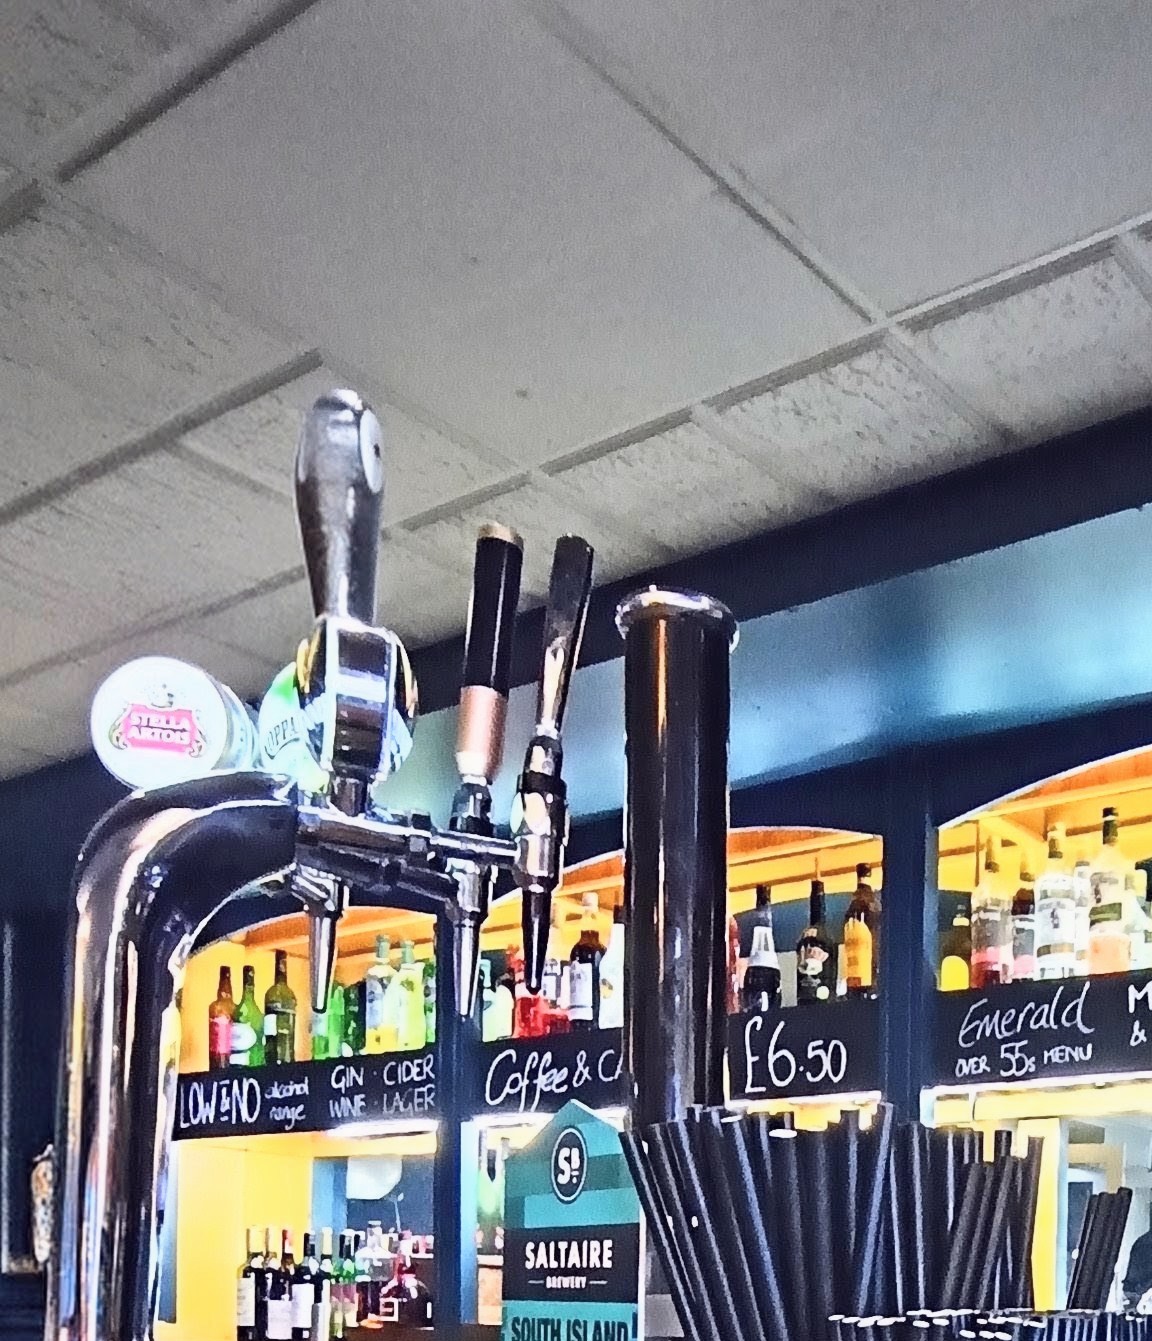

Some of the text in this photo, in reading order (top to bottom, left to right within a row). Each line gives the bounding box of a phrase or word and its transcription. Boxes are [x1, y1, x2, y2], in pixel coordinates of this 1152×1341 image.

[128, 726, 191, 746] ARTOIS
[130, 712, 190, 732] STELLA
[957, 981, 1095, 1048] Emerald
[1130, 1020, 1147, 1047] &
[330, 1054, 436, 1090] GIN CIDER
[744, 1015, 847, 1095] £6.50
[955, 1056, 990, 1078] OVER
[1043, 1043, 1093, 1067] MENU
[485, 1049, 568, 1112] Coffee
[572, 1050, 593, 1087] &
[179, 1080, 218, 1130] LOW
[231, 1077, 262, 1125] NO
[269, 1103, 307, 1131] range
[328, 1084, 436, 1119] WINE LAGER
[525, 1240, 613, 1270] SALTAIRE
[546, 1275, 587, 1289] BREWERY
